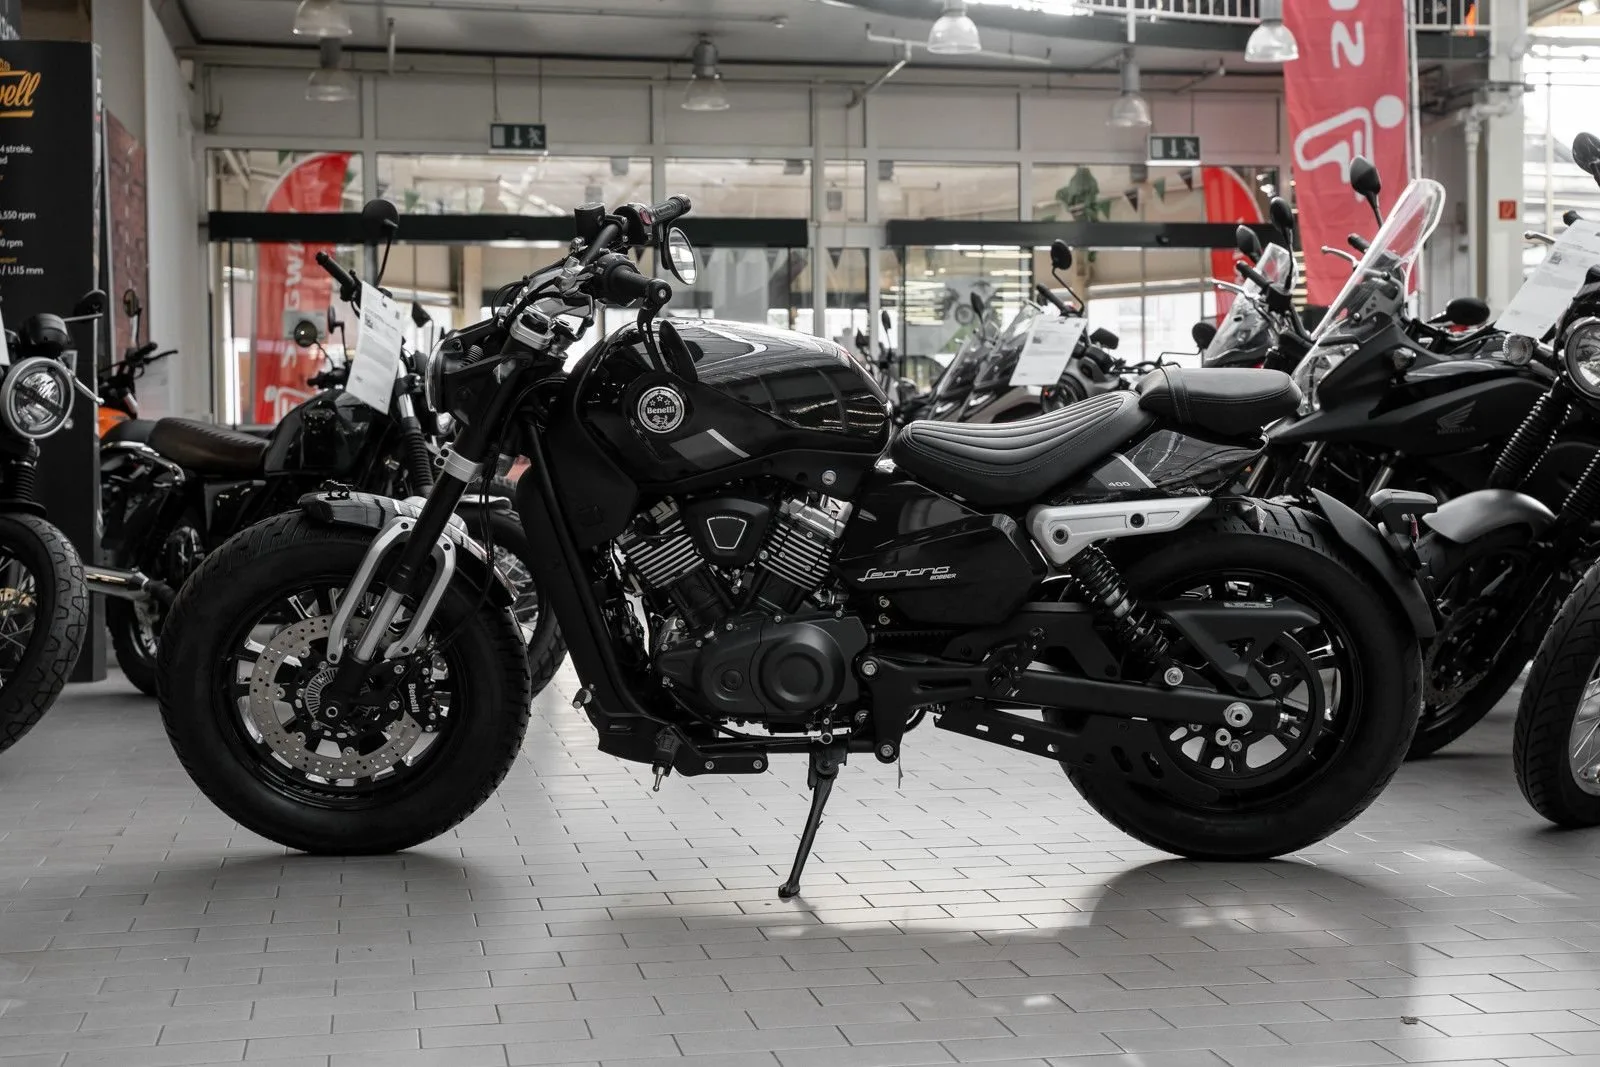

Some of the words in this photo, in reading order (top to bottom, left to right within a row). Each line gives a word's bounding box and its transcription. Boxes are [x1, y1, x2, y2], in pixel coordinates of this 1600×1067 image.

[6, 144, 34, 155] stroke,
[18, 212, 37, 222] rpm
[6, 240, 24, 249] rpm
[25, 267, 44, 275] mm
[646, 405, 675, 414] Benelli
[408, 683, 420, 713] Benelli
